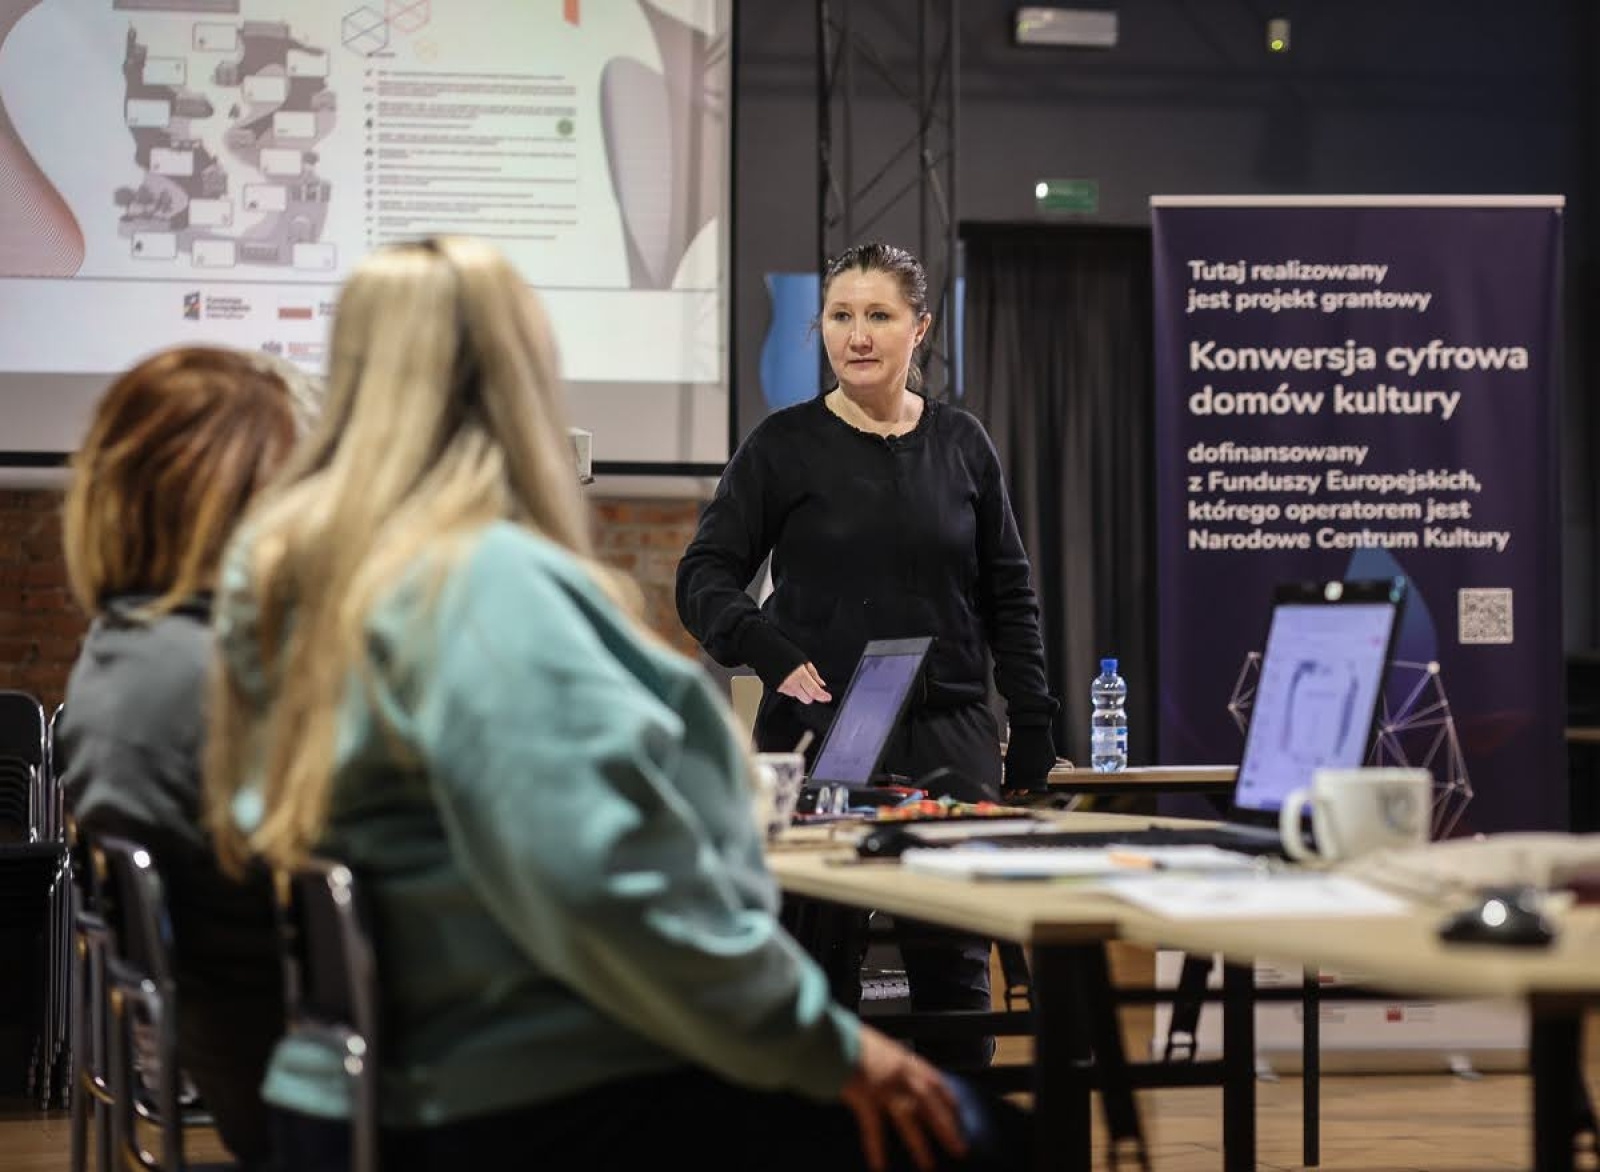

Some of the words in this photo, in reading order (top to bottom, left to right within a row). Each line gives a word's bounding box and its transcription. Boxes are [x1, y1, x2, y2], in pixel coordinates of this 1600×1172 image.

[1188, 260, 1246, 284] Tutaj
[1251, 260, 1388, 284] realizowany
[1187, 289, 1232, 313] jest
[1236, 288, 1317, 313] projekt
[1320, 290, 1432, 313] grantowy
[1190, 340, 1377, 376] Konwersja
[1385, 340, 1529, 376] cyfrowa
[1188, 383, 1325, 415] domów
[1334, 384, 1461, 420] kultury
[1187, 442, 1369, 466] dofinansowany
[1188, 476, 1203, 492] z
[1208, 471, 1322, 495] Funduszy
[1326, 470, 1482, 494] Europejskich,
[1188, 500, 1281, 524] którego
[1284, 501, 1422, 523] operatorem
[1424, 499, 1472, 523] jest
[1188, 529, 1311, 550] Narodowe
[1316, 528, 1419, 549] Centrum
[1423, 527, 1511, 552] Kultury
